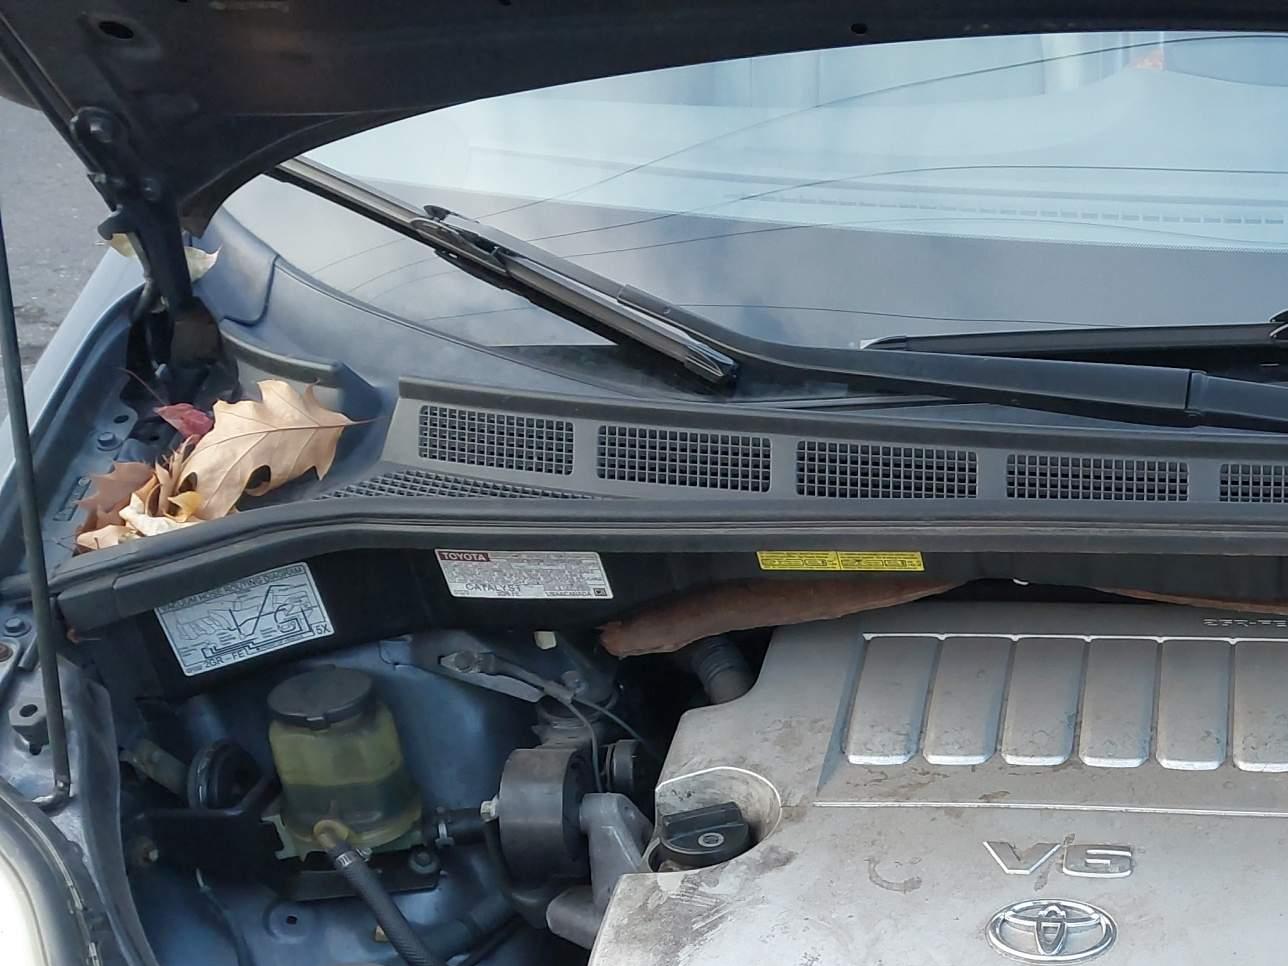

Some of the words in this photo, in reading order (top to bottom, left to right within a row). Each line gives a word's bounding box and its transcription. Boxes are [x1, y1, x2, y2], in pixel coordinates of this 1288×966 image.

[443, 552, 487, 561] TOYOTA
[465, 583, 521, 592] CATALYST
[316, 624, 331, 635] 5X
[983, 841, 1132, 879] V6
